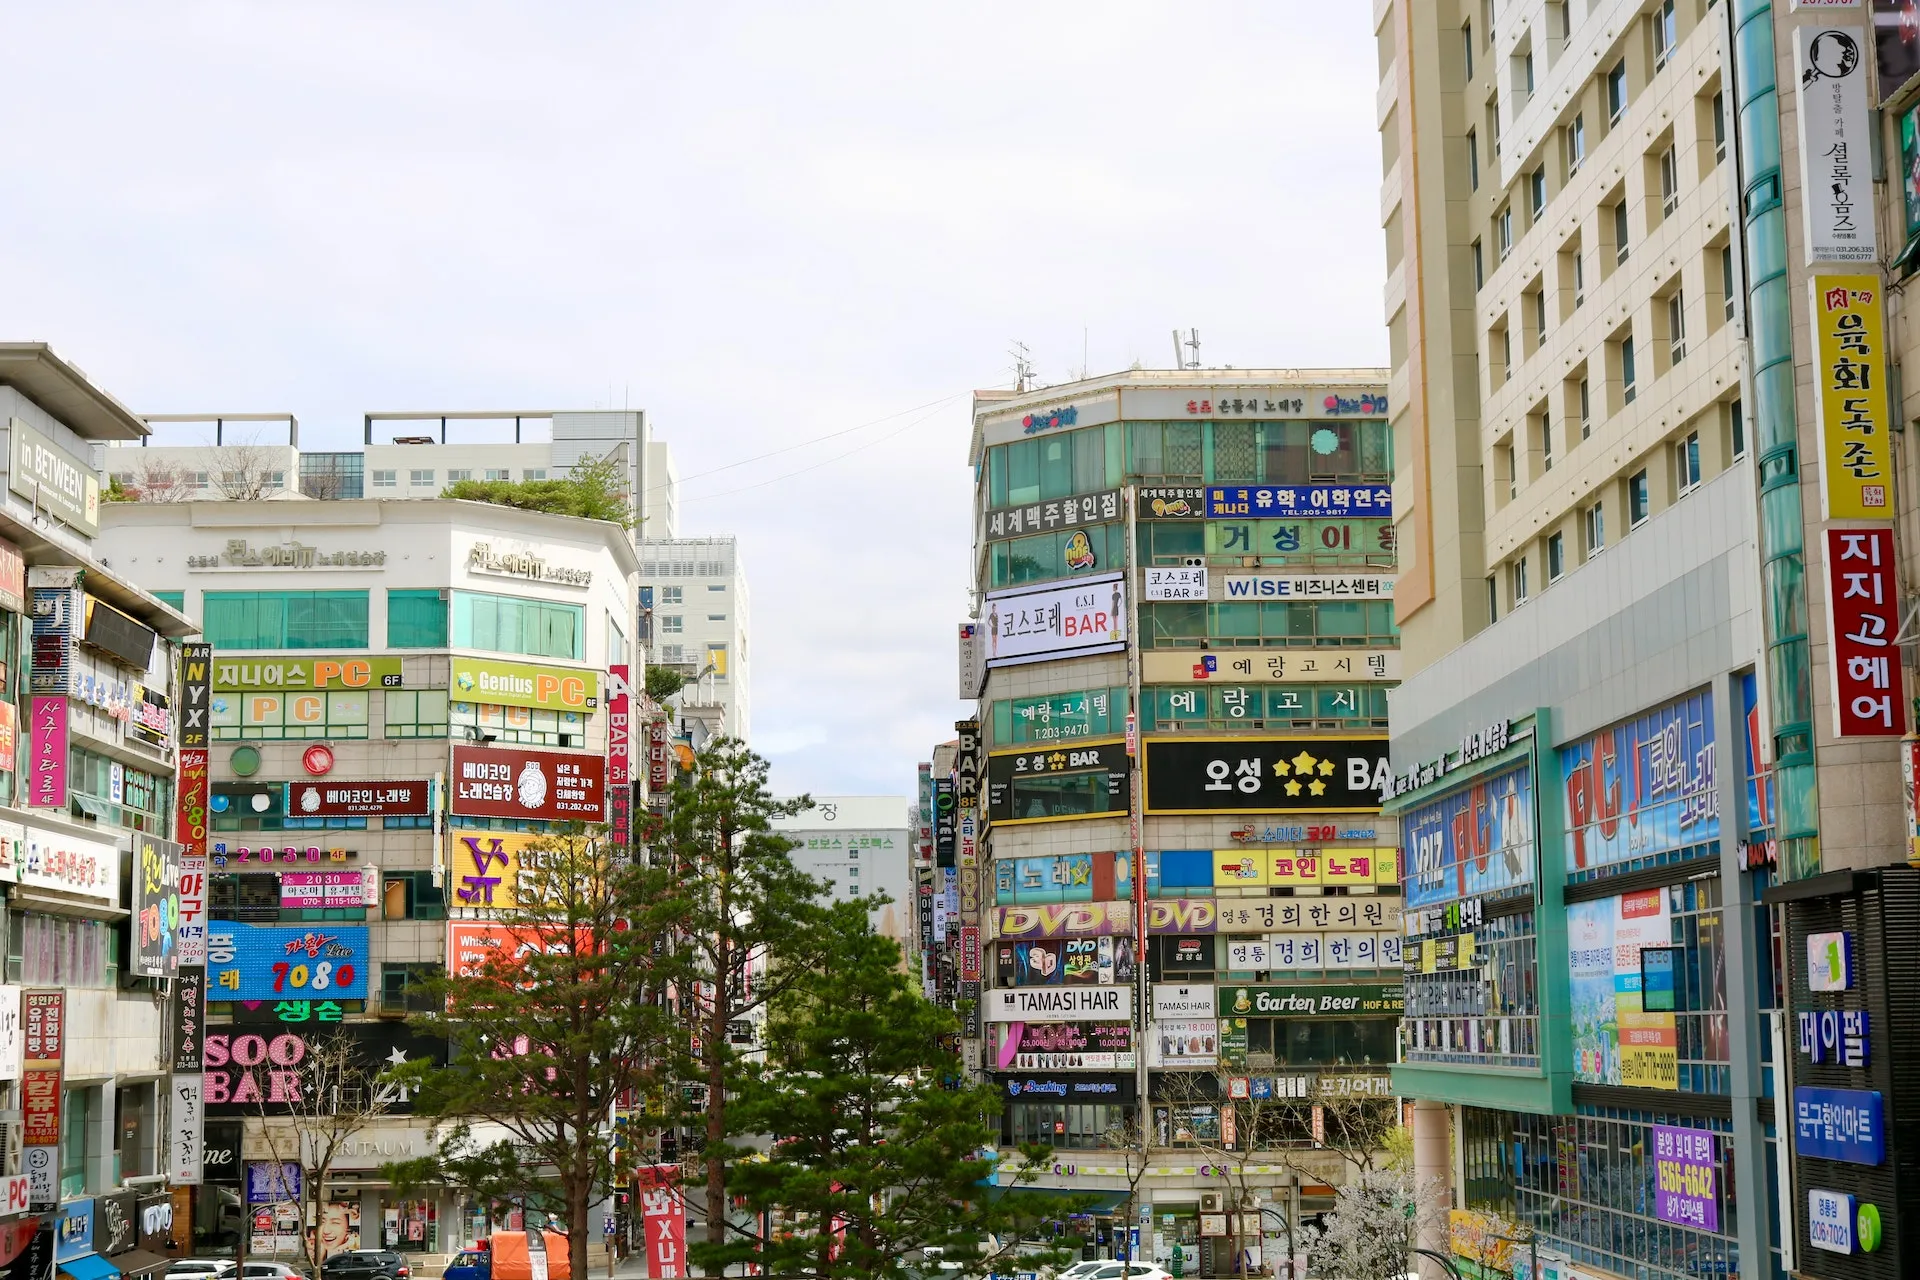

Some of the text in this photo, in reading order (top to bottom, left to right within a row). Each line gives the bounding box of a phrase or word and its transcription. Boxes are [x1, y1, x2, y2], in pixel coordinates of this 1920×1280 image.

[1822, 142, 1857, 231] 셜록홈즈
[1832, 314, 1880, 478] 육회독존
[22, 433, 84, 503] in BETWEEN
[1140, 489, 1203, 499] 세계맥주할인점
[1213, 491, 1249, 501] 미국
[989, 491, 1117, 536] 세계맥주할인점
[1213, 505, 1250, 514] 캐나다
[1149, 570, 1205, 588] 코스프레
[1227, 578, 1380, 596] WISE 비즈니스센터
[1075, 593, 1095, 609] C.S.I
[1163, 588, 1190, 598] BAR
[1002, 602, 1107, 638] 코스프레 BAR
[1840, 534, 1893, 728] 지지고헤어
[183, 647, 209, 658] BAR
[218, 660, 400, 688] 지니어스 PC 6F
[1232, 655, 1386, 678] 예랑고시텔
[185, 662, 207, 728] NYX
[479, 671, 533, 694] Genius
[536, 673, 585, 706] PC
[251, 696, 321, 723] PC
[1021, 694, 1107, 723] 예랑 고시텔
[1169, 687, 1389, 718] 예랑고시
[479, 704, 530, 727] PC
[184, 734, 203, 744] 2F
[609, 712, 628, 757] BAR
[1034, 724, 1090, 740] T.203-9470
[38, 701, 62, 793] 사주&타로
[462, 762, 511, 781] 베어코인
[960, 734, 976, 794] BAR
[1015, 750, 1100, 772] 오성 BAR
[611, 766, 627, 780] 3F
[1204, 757, 1391, 794] 오성 BA
[40, 795, 54, 804] 4F
[326, 789, 411, 804] 베어코인 노래방
[459, 782, 514, 802] 노래연습장
[960, 797, 977, 808] 8F
[556, 802, 599, 812] 031.202.4279
[1261, 827, 1303, 843] 쇼미더
[1306, 825, 1336, 843] 코인
[236, 847, 345, 864] 2030 4F
[962, 837, 974, 857] 노래
[306, 874, 341, 884] 2030
[1022, 859, 1072, 888] 노래
[1274, 858, 1317, 878] 코인
[1328, 857, 1370, 877] 노래
[179, 873, 204, 922] 야구
[960, 868, 978, 913] DVD
[140, 893, 179, 949] 7080
[1001, 904, 1104, 937] DVD
[1150, 900, 1216, 932] DVD
[1221, 902, 1383, 928] 영통 경희한의원
[323, 943, 354, 959] Live
[460, 936, 502, 948] Whiskey
[1066, 940, 1096, 954] DVD
[1233, 946, 1266, 963] 영통
[1275, 937, 1401, 964] 경희한의원
[460, 951, 485, 963] Wine
[1068, 955, 1092, 966] 상영관
[272, 961, 356, 993] 7080
[28, 995, 61, 1006] 성인PC
[1017, 991, 1119, 1011] TAMASI HAIR
[1158, 1001, 1211, 1011] TAMASI HAIR
[1255, 992, 1391, 1014] Garten Beer HOF &
[28, 1007, 42, 1053] 유리방
[45, 1007, 60, 1052] 전화방
[205, 1033, 305, 1067] SOO
[205, 1069, 302, 1104] BAR
[1321, 1077, 1393, 1097] 포차어게
[27, 1082, 56, 1128] 컴퓨터
[1798, 1102, 1873, 1145] 문구할인마트
[202, 1141, 233, 1165] ine
[1657, 1132, 1711, 1163] 분양 임대 문의
[1657, 1160, 1714, 1200] 1566-6642
[9, 1178, 28, 1211] PC
[1665, 1197, 1680, 1219] 상가
[1818, 1197, 1838, 1219] 영통점
[1858, 1215, 1873, 1241] B1
